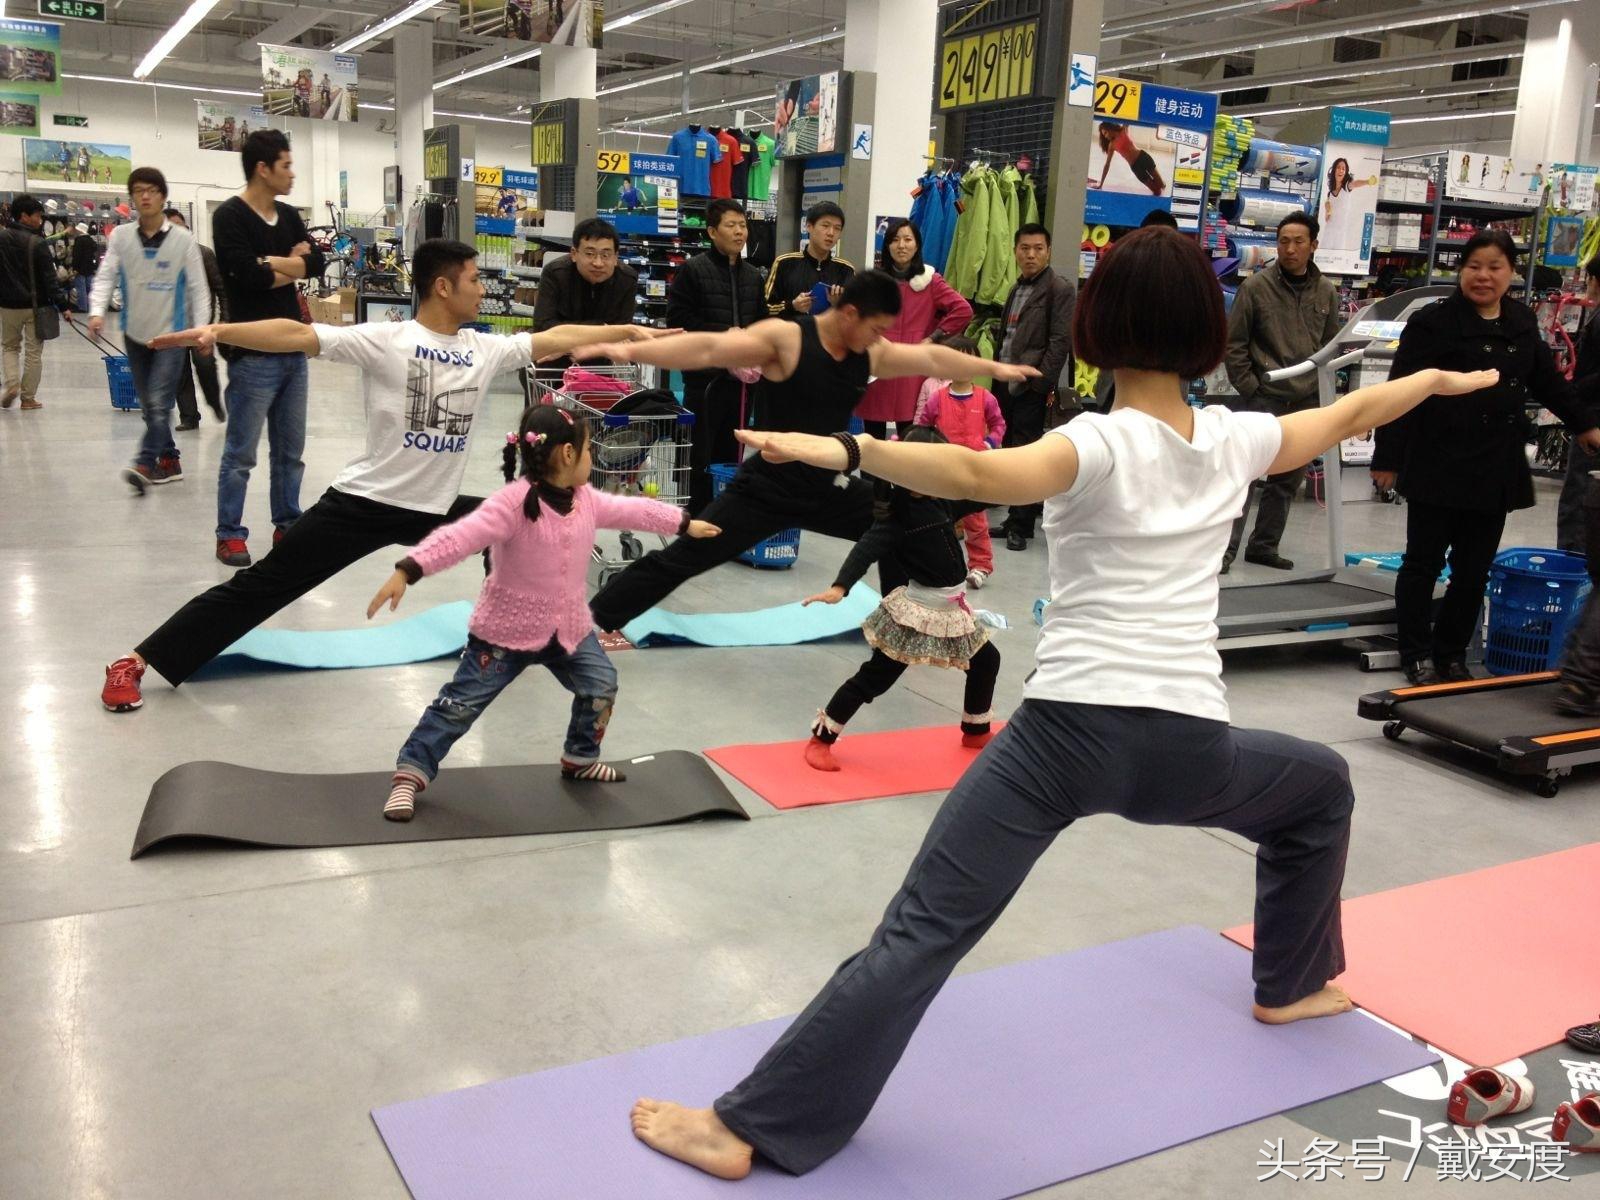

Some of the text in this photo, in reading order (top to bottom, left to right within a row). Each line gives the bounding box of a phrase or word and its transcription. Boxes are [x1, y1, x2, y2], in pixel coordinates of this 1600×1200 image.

[62, 9, 83, 17] EXIT
[1094, 80, 1128, 115] 29
[1155, 96, 1203, 119] 健身运动
[1166, 128, 1200, 146] 蓝色货品
[597, 152, 622, 171] 59
[633, 159, 675, 173] 球拍类运动
[506, 174, 538, 185] 羽毛球运
